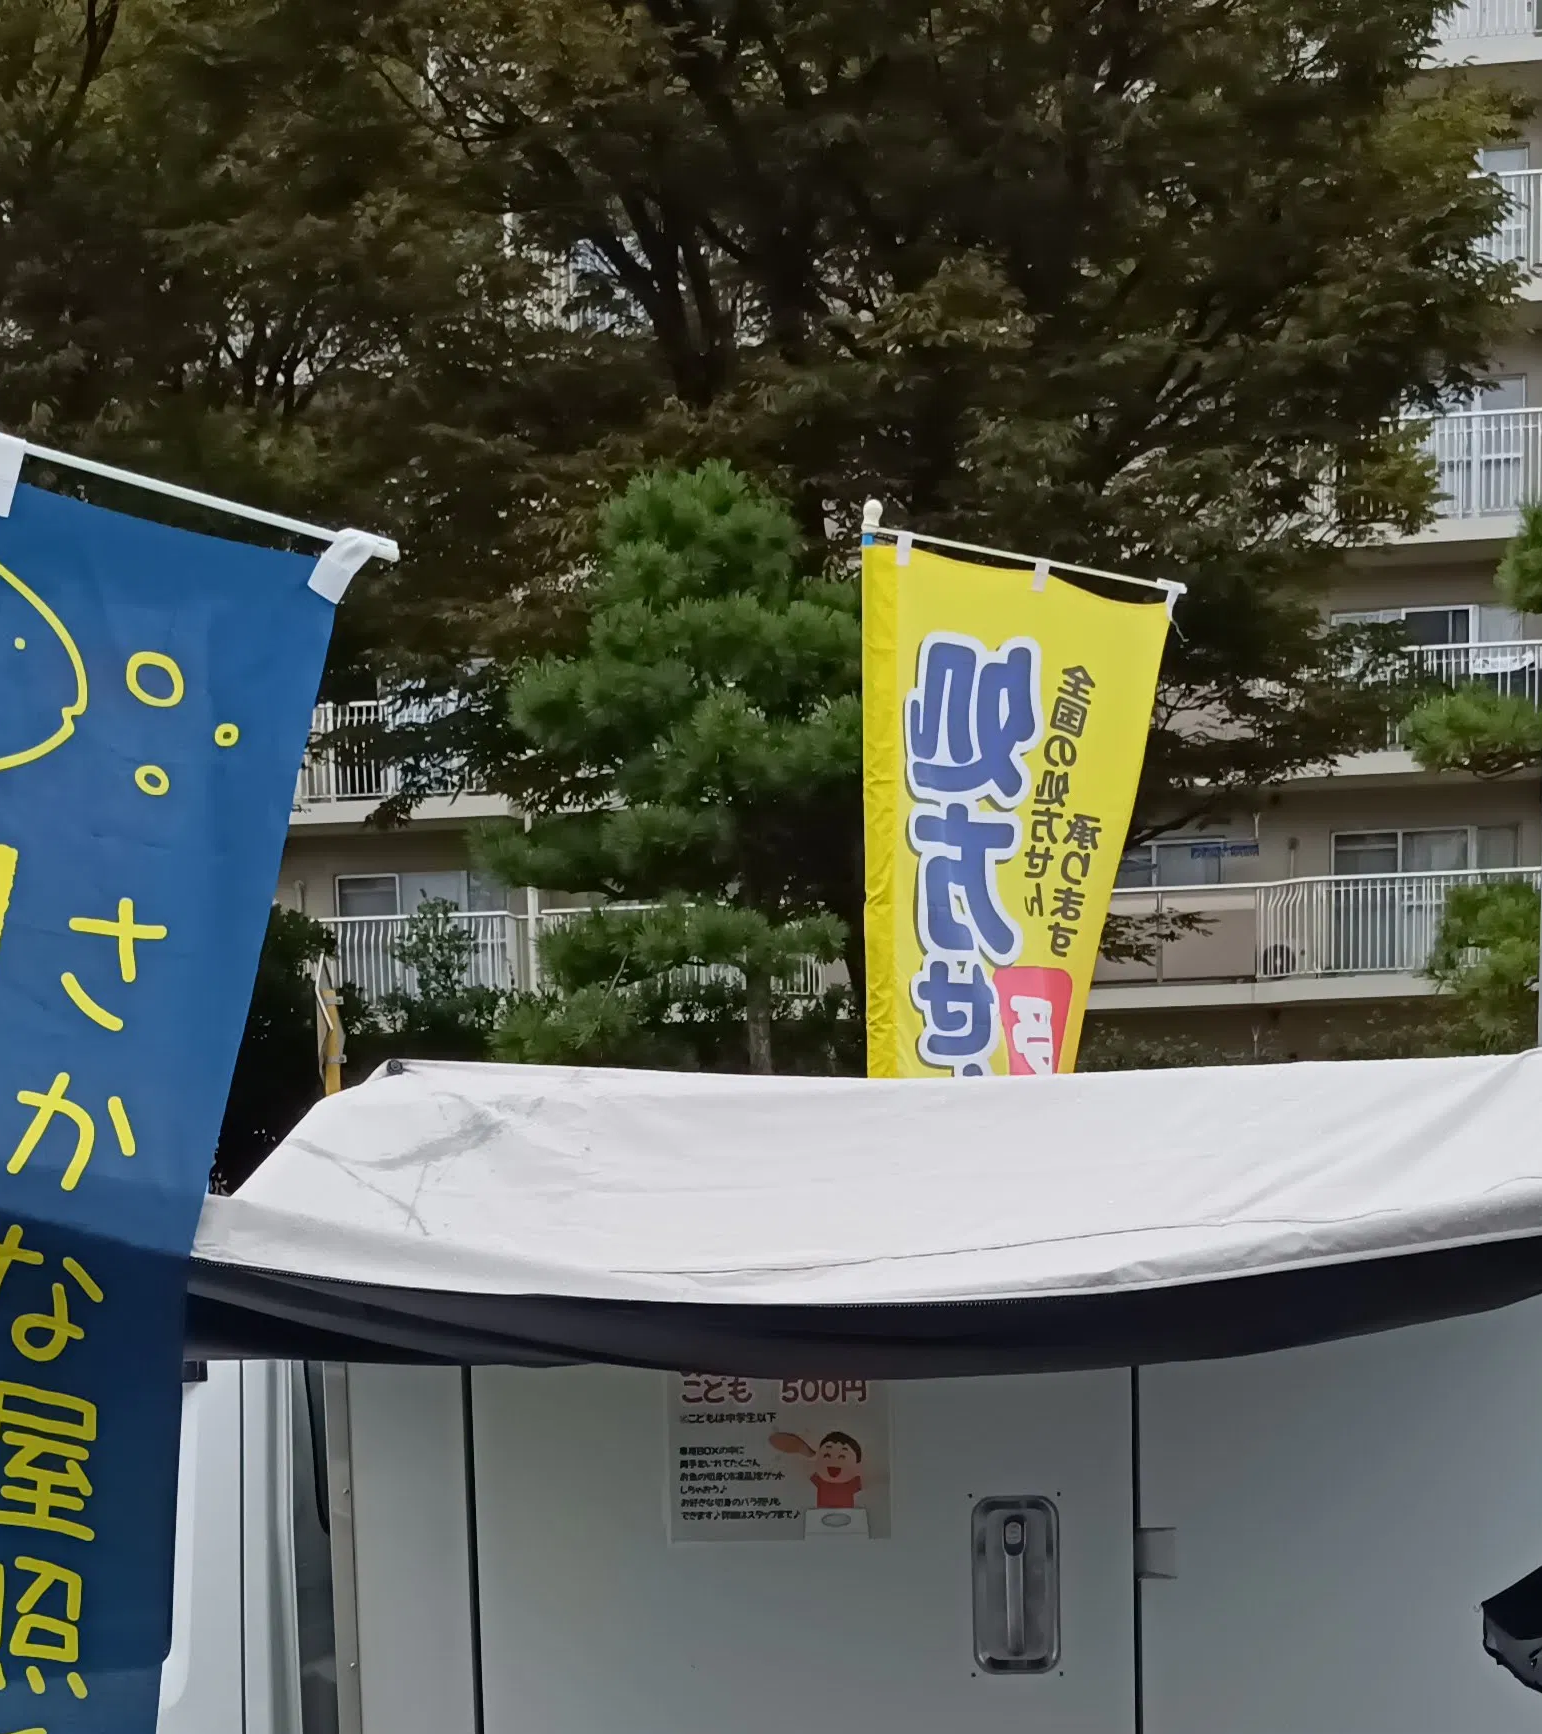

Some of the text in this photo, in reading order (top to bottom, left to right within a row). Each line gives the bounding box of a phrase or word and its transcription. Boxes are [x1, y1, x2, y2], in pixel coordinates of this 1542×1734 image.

[681, 1378, 867, 1403] こども 500円
